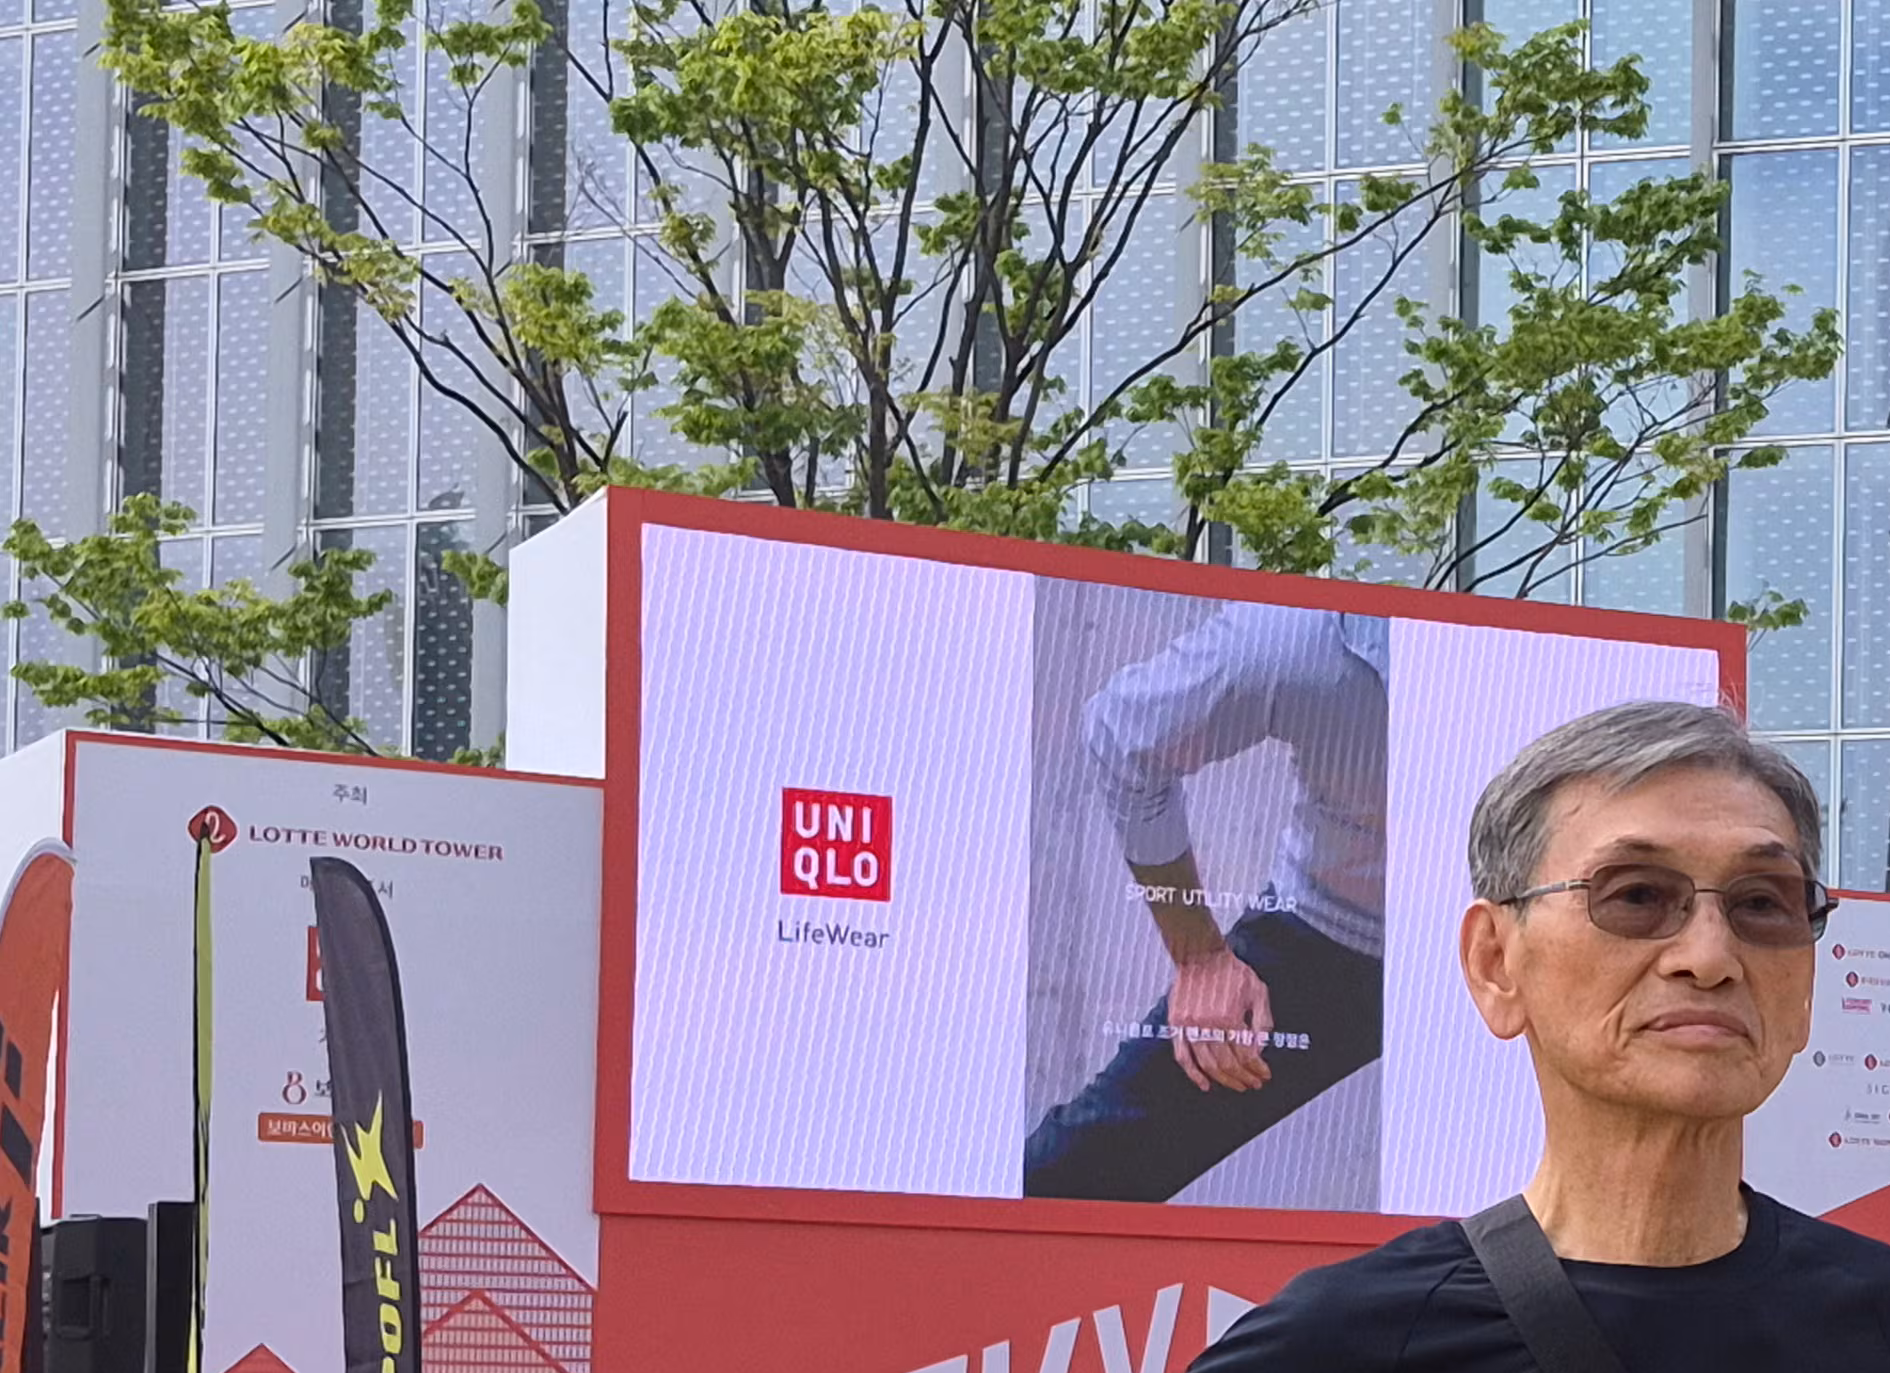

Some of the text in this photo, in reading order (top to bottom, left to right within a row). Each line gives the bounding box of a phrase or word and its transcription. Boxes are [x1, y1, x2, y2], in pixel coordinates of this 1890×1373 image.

[332, 783, 369, 805] 주최
[793, 800, 873, 844] UNI
[249, 825, 504, 861] LOTTE WORLD TOWER
[793, 846, 879, 890] QLO
[1124, 882, 1299, 914] SPORT UTILITY WEAR
[778, 919, 890, 949] LifeWear
